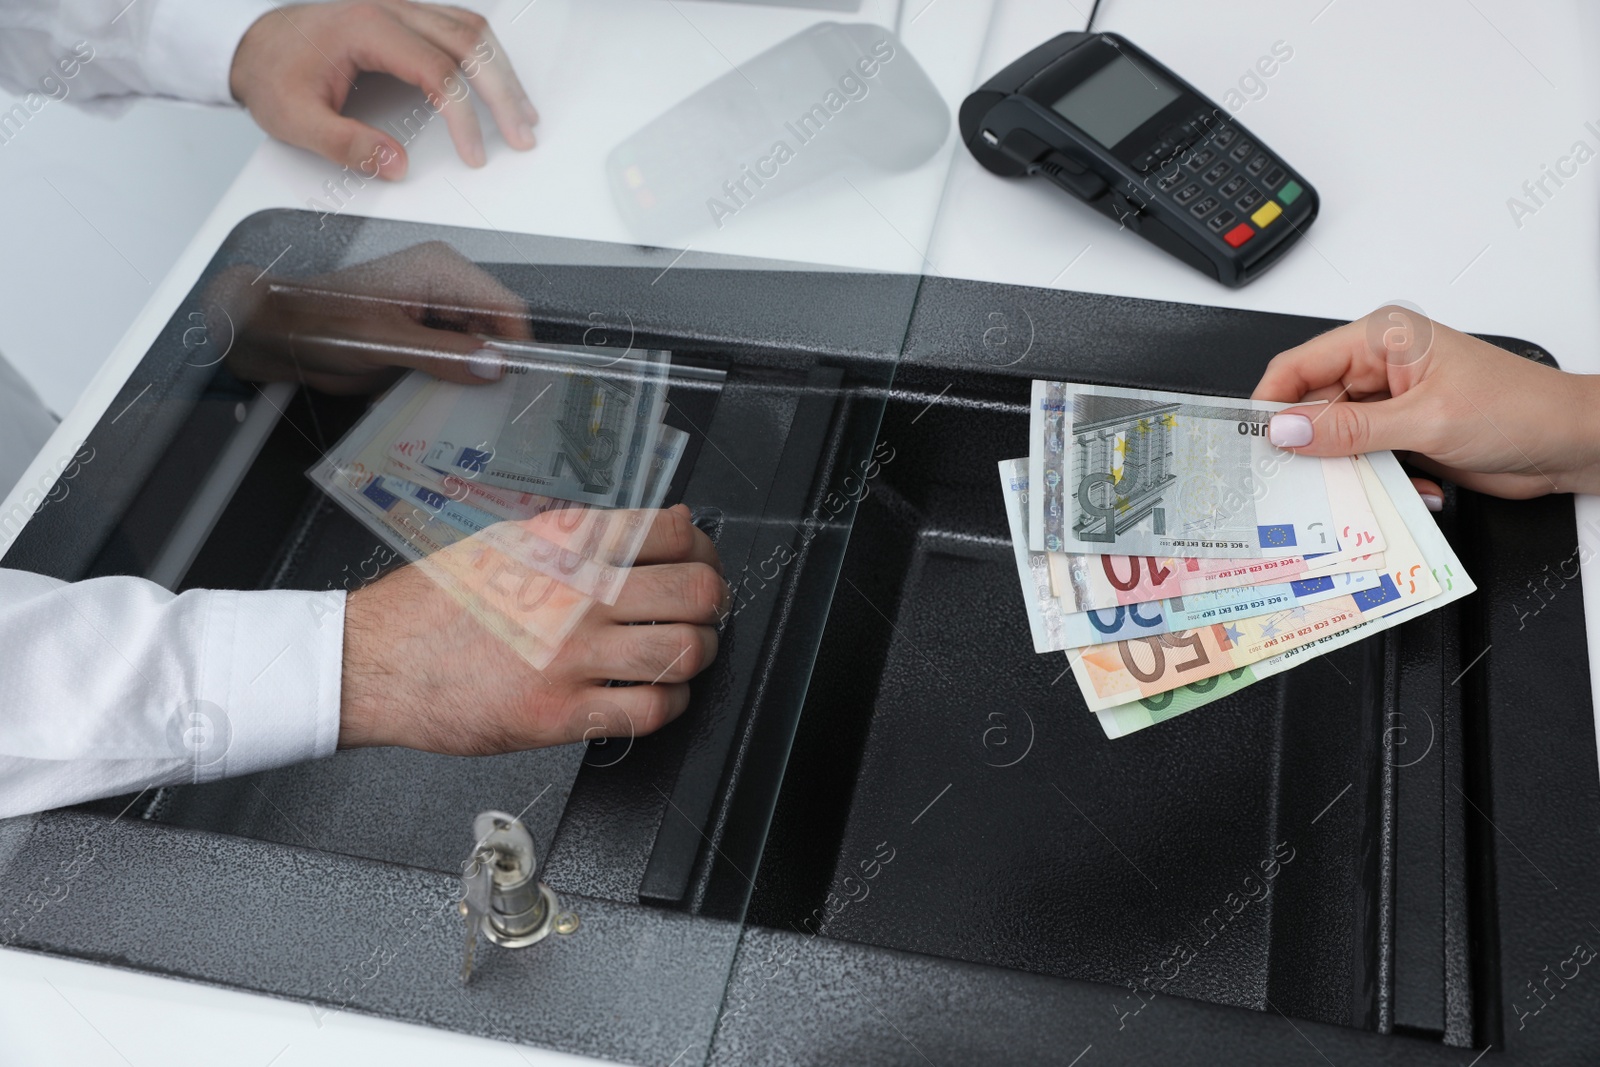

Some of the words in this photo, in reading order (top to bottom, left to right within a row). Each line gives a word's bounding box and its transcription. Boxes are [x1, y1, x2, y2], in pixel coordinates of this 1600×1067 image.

[1237, 421, 1270, 437] URO
[1078, 472, 1115, 543] 5
[1249, 565, 1262, 573] EZB
[1268, 596, 1282, 605] BCE
[1332, 613, 1347, 623] BCE
[1314, 621, 1329, 630] ECB
[1297, 627, 1312, 636] EZB
[1281, 633, 1295, 642] EKT
[1264, 640, 1279, 649] EKP
[1302, 642, 1316, 652] EKT
[1284, 648, 1300, 659] EKP
